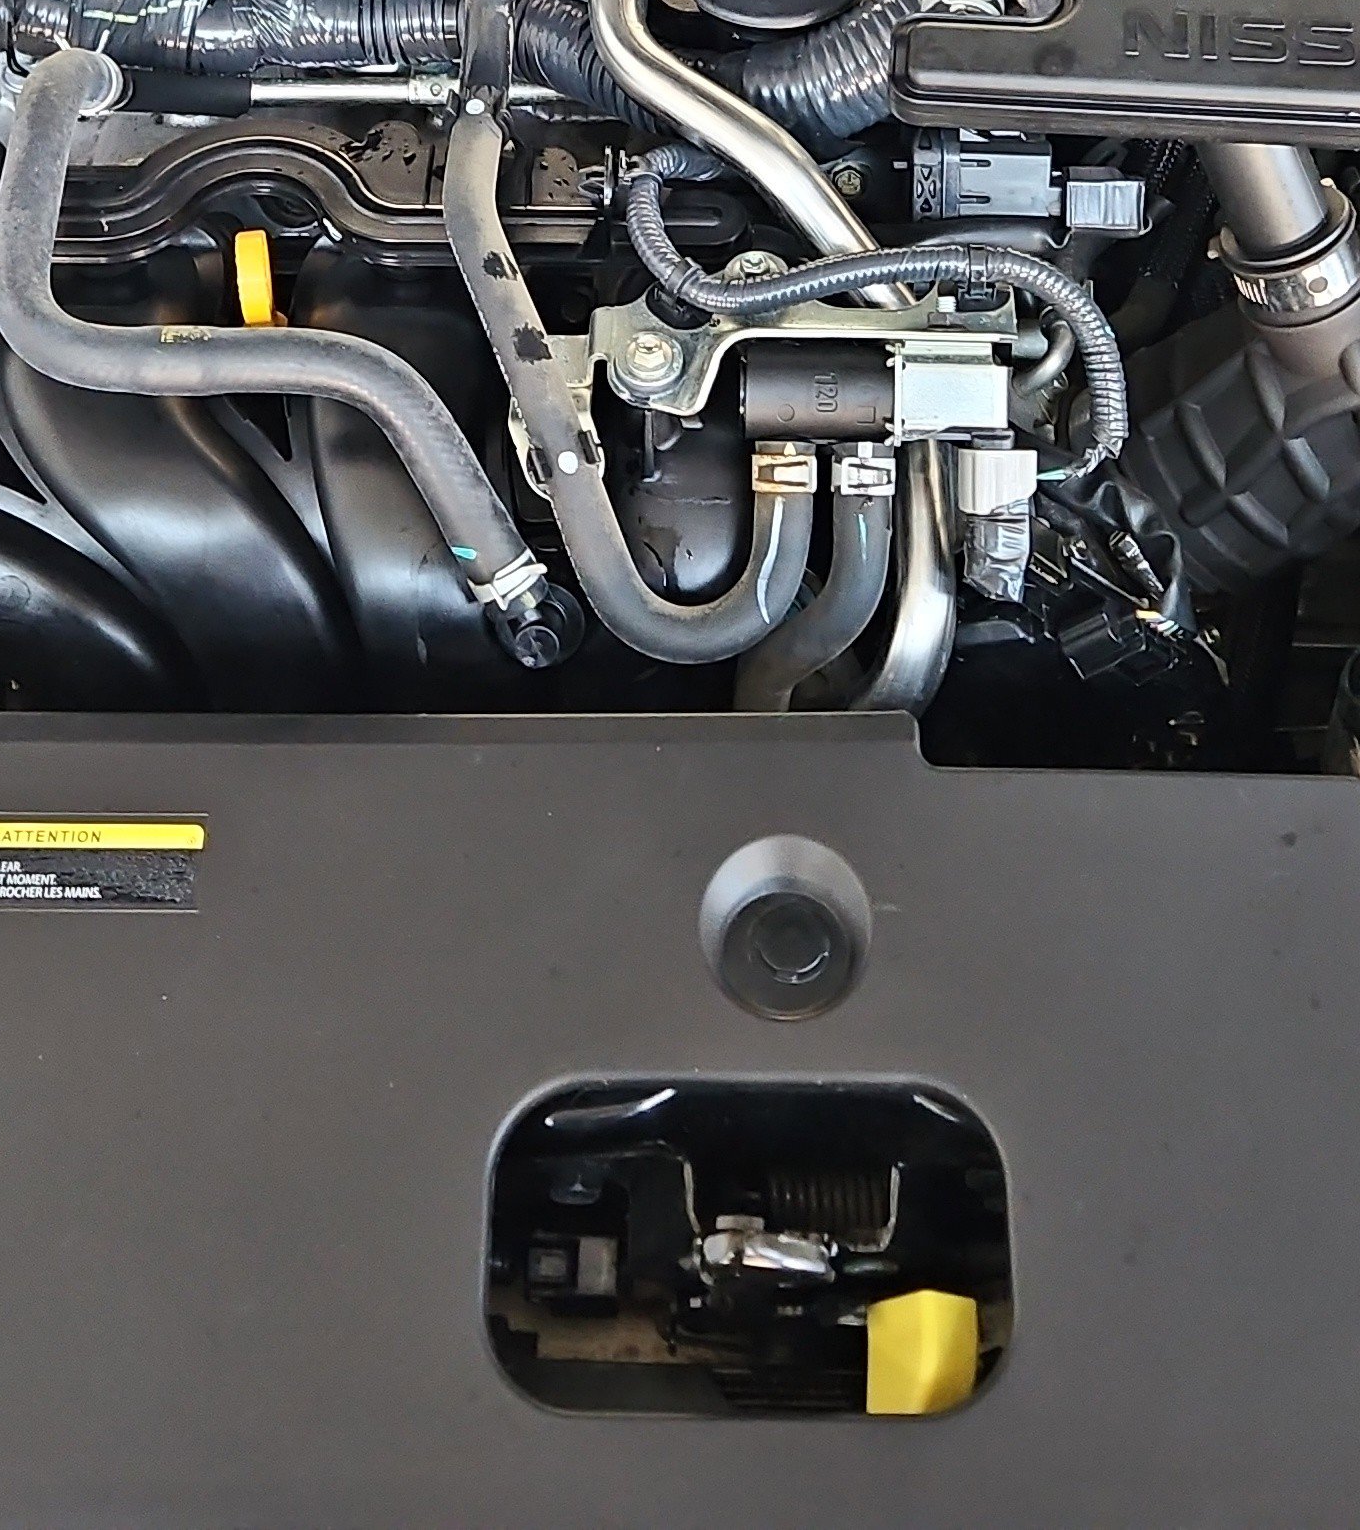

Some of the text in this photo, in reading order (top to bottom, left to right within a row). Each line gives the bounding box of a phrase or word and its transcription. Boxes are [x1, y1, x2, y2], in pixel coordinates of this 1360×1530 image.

[813, 372, 837, 414] 120
[1, 829, 103, 843] ATTENTION
[44, 887, 62, 898] LES
